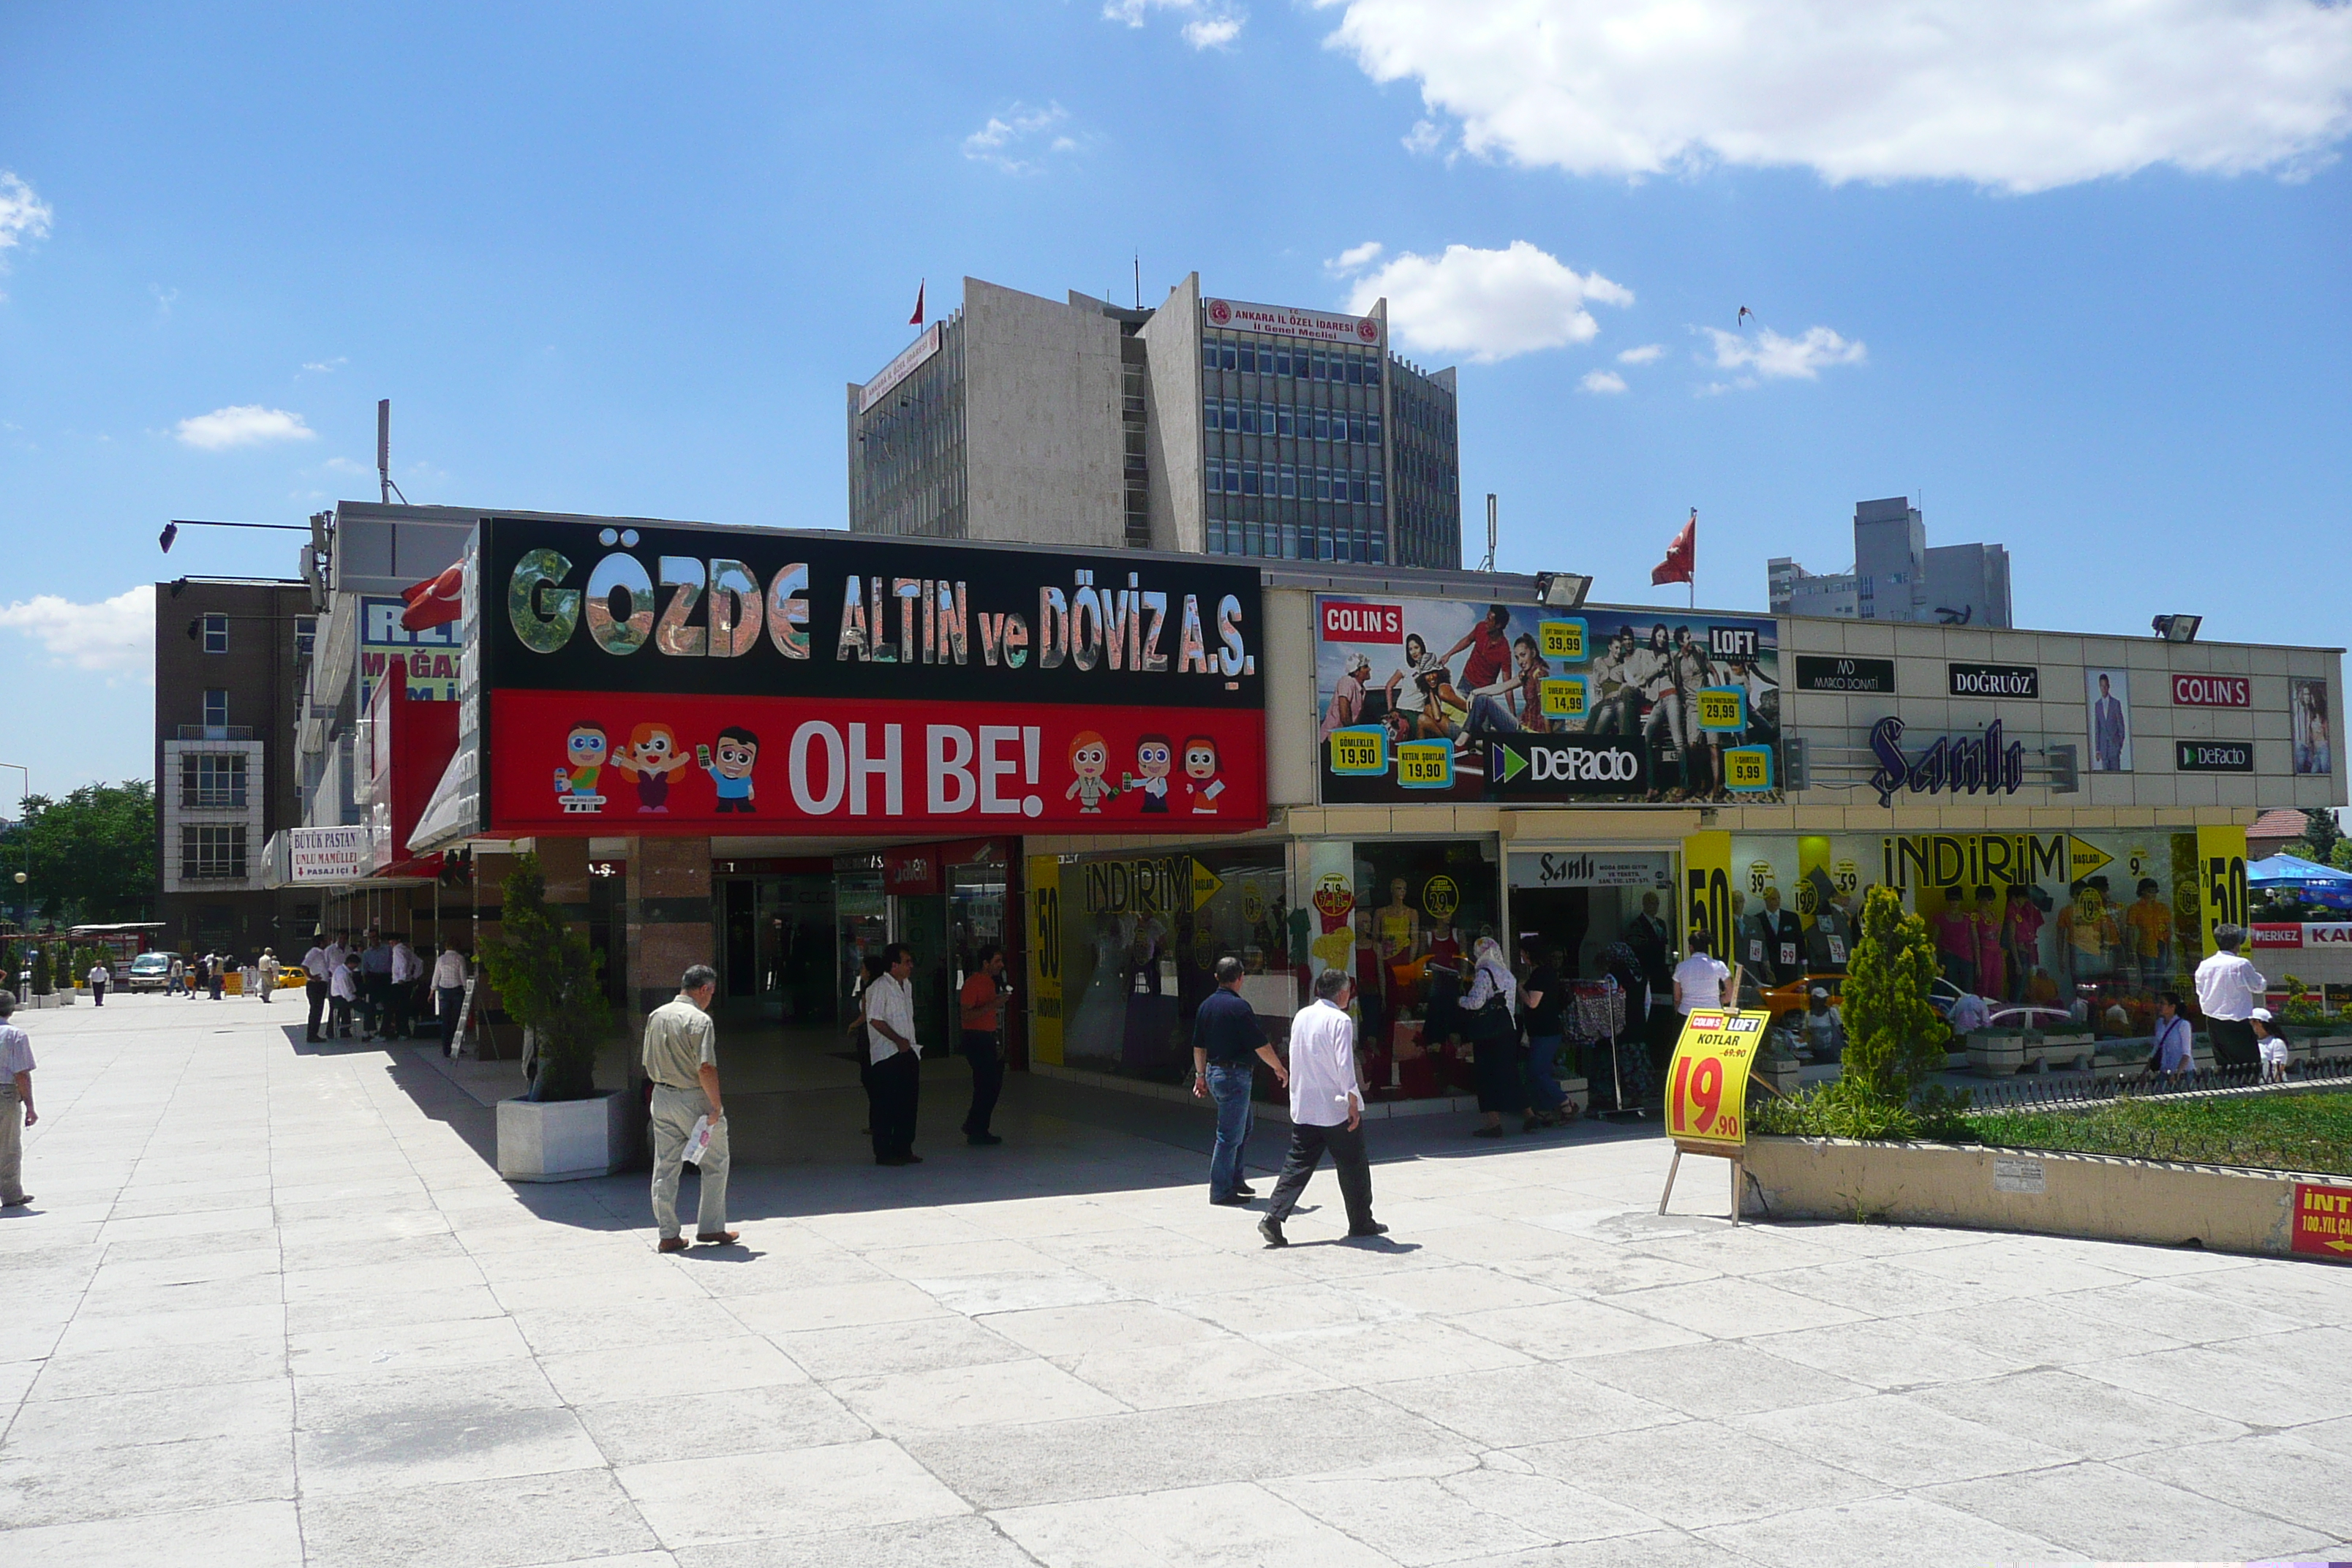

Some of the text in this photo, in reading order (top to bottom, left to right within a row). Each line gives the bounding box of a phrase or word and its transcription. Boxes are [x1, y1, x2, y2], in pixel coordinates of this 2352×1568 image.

[1235, 310, 1354, 332] ANKARA İL ÖZEL İDARESİ
[1264, 324, 1294, 335] Genel
[1298, 328, 1337, 340] Meclisi
[508, 528, 810, 659] GÖZDE
[837, 575, 968, 664] ALTIN
[978, 611, 1028, 669] ve
[1039, 568, 1169, 673] DÖVİZ
[1177, 593, 1255, 690] A.Ş.
[1548, 636, 1580, 652] 39,99
[1712, 629, 1755, 655] LOFT
[1814, 676, 1845, 690] MARCO
[1956, 669, 2032, 694] DOĞRUÖZ
[1553, 696, 1582, 712] 14,99
[1706, 704, 1735, 720] 29,99
[1339, 736, 1374, 747] GÖMLEKLER
[1340, 748, 1375, 766] 19,90
[1402, 752, 1419, 761] KETEN
[1530, 746, 1638, 781] DeFacto
[2198, 747, 2246, 765] DeFacto
[789, 720, 1044, 818] OH BE!
[1408, 764, 1441, 779] 19,90
[1736, 765, 1760, 781] 9,99
[294, 831, 323, 849] BÜYÜK
[295, 853, 316, 864] UNLU
[1884, 834, 2065, 889] İNDİRİM
[2073, 853, 2100, 866] BAŞLADI
[306, 866, 349, 876] PASAJ İÇİ
[1751, 874, 1765, 894] 39
[1840, 872, 1857, 892] 59
[2255, 928, 2352, 943] MERKEZ KA
[1782, 950, 1795, 964] 99
[1727, 1018, 1759, 1031] LOFT
[1697, 1033, 1740, 1047] KOTLAR
[2338, 1218, 2352, 1240] ÇA
